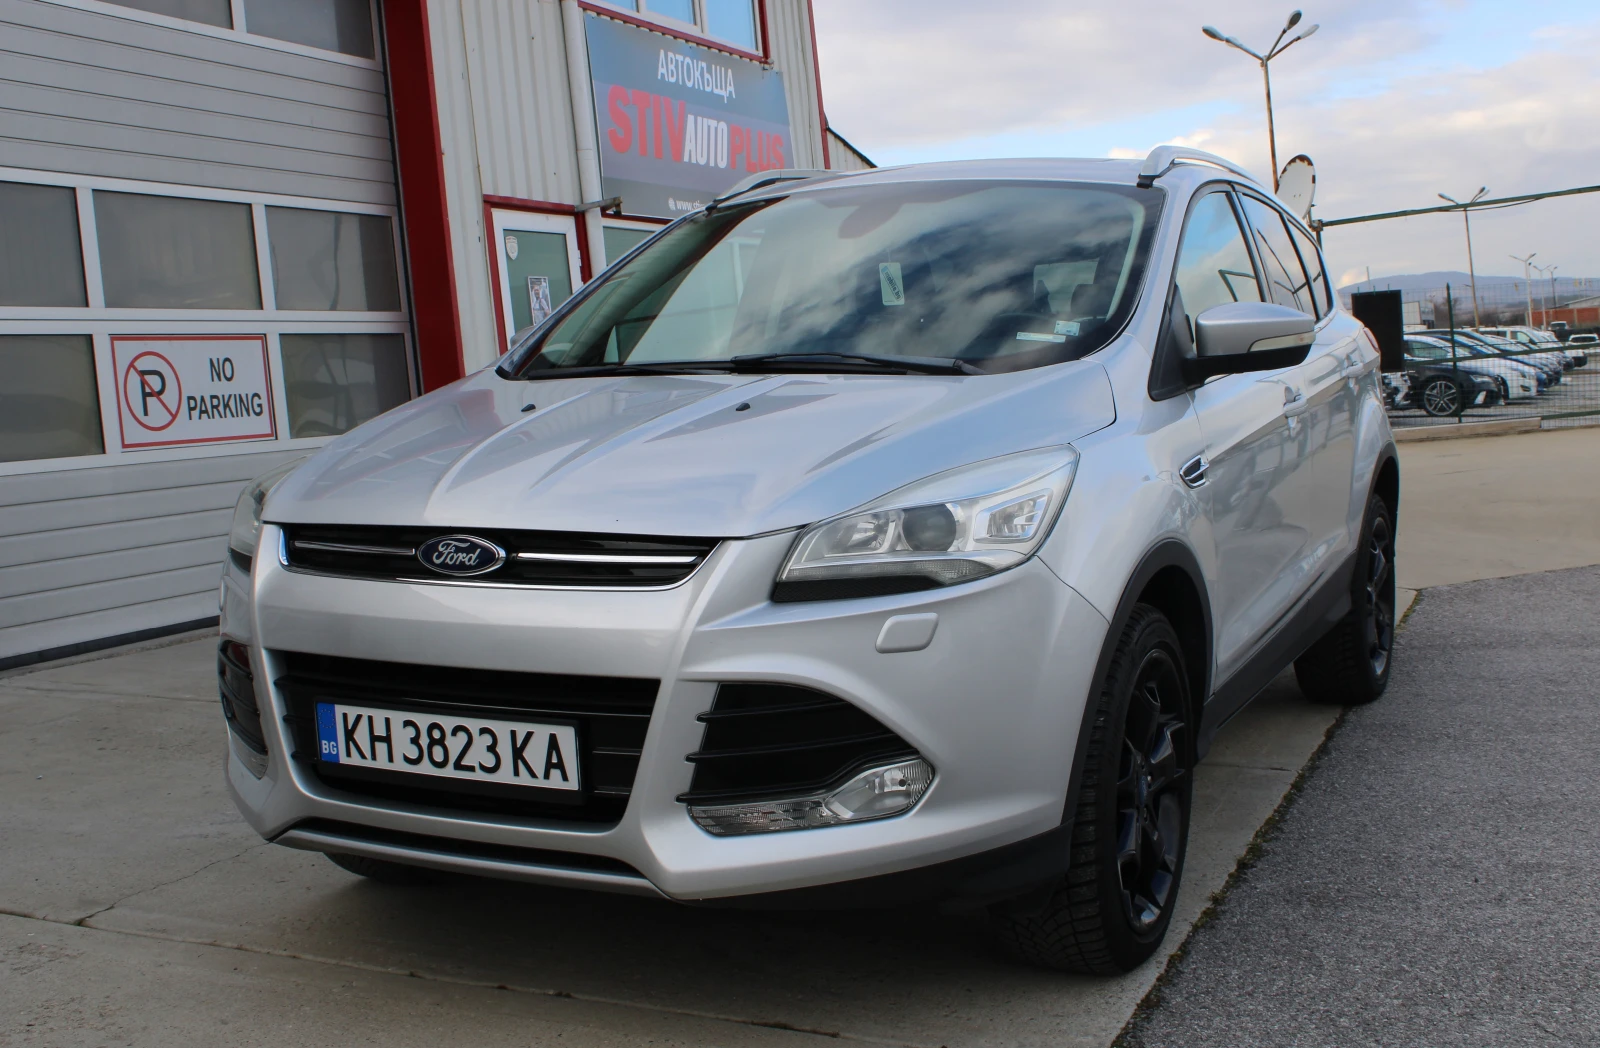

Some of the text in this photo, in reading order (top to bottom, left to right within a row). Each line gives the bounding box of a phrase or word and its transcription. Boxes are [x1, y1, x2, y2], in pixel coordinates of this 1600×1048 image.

[657, 49, 736, 103] АВТОКЪЩА
[607, 84, 785, 173] STIV AUTO PLUS
[208, 357, 235, 382] NO
[187, 392, 264, 421] PARKING
[432, 540, 482, 566] Ford
[321, 740, 338, 755] BG
